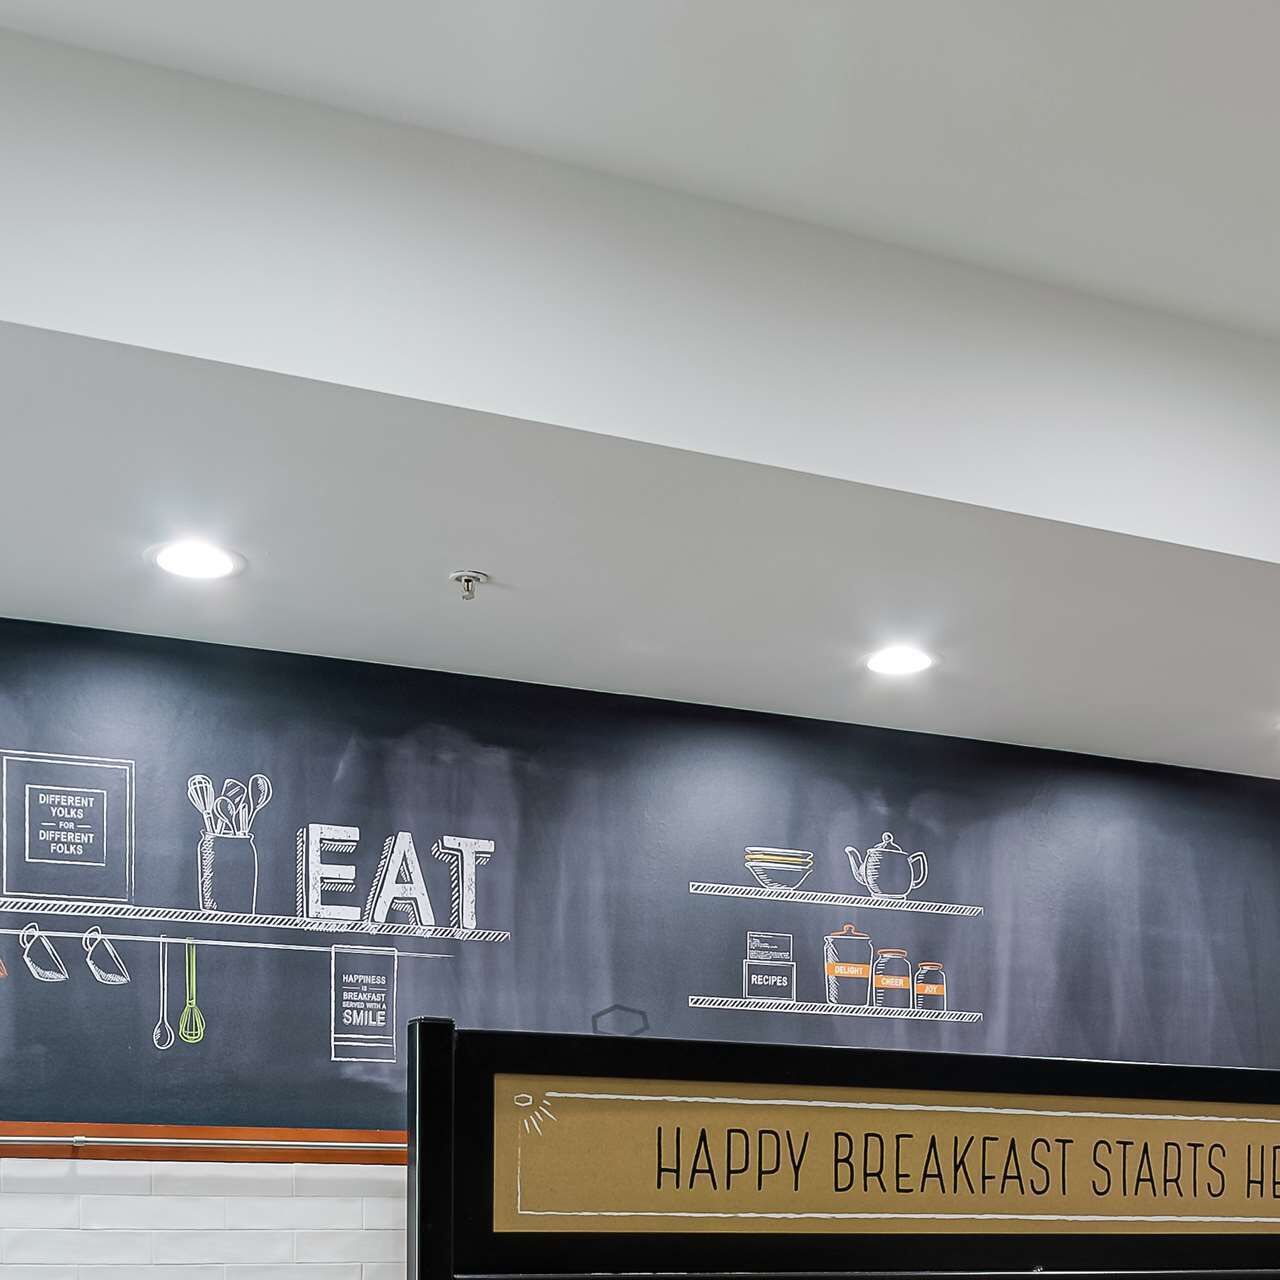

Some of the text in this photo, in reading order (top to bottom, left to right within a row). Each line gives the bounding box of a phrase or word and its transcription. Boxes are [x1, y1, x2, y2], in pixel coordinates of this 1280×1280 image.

[39, 793, 95, 808] DIFFERENT
[50, 807, 84, 819] YOLKS
[59, 821, 75, 830] FOR
[39, 830, 95, 844] DIFFERENT
[50, 843, 84, 855] FOLKS
[300, 823, 496, 930] EAT
[834, 964, 864, 976] DELIGHT
[342, 974, 387, 985] HAPPINESS
[751, 974, 789, 987] RECIPES
[342, 992, 387, 1002] BREAKFAST
[342, 1009, 387, 1027] SMILE
[656, 1126, 810, 1192] HAPPY
[832, 1131, 1075, 1198] BREAKFAST
[1091, 1140, 1227, 1199] STARTS
